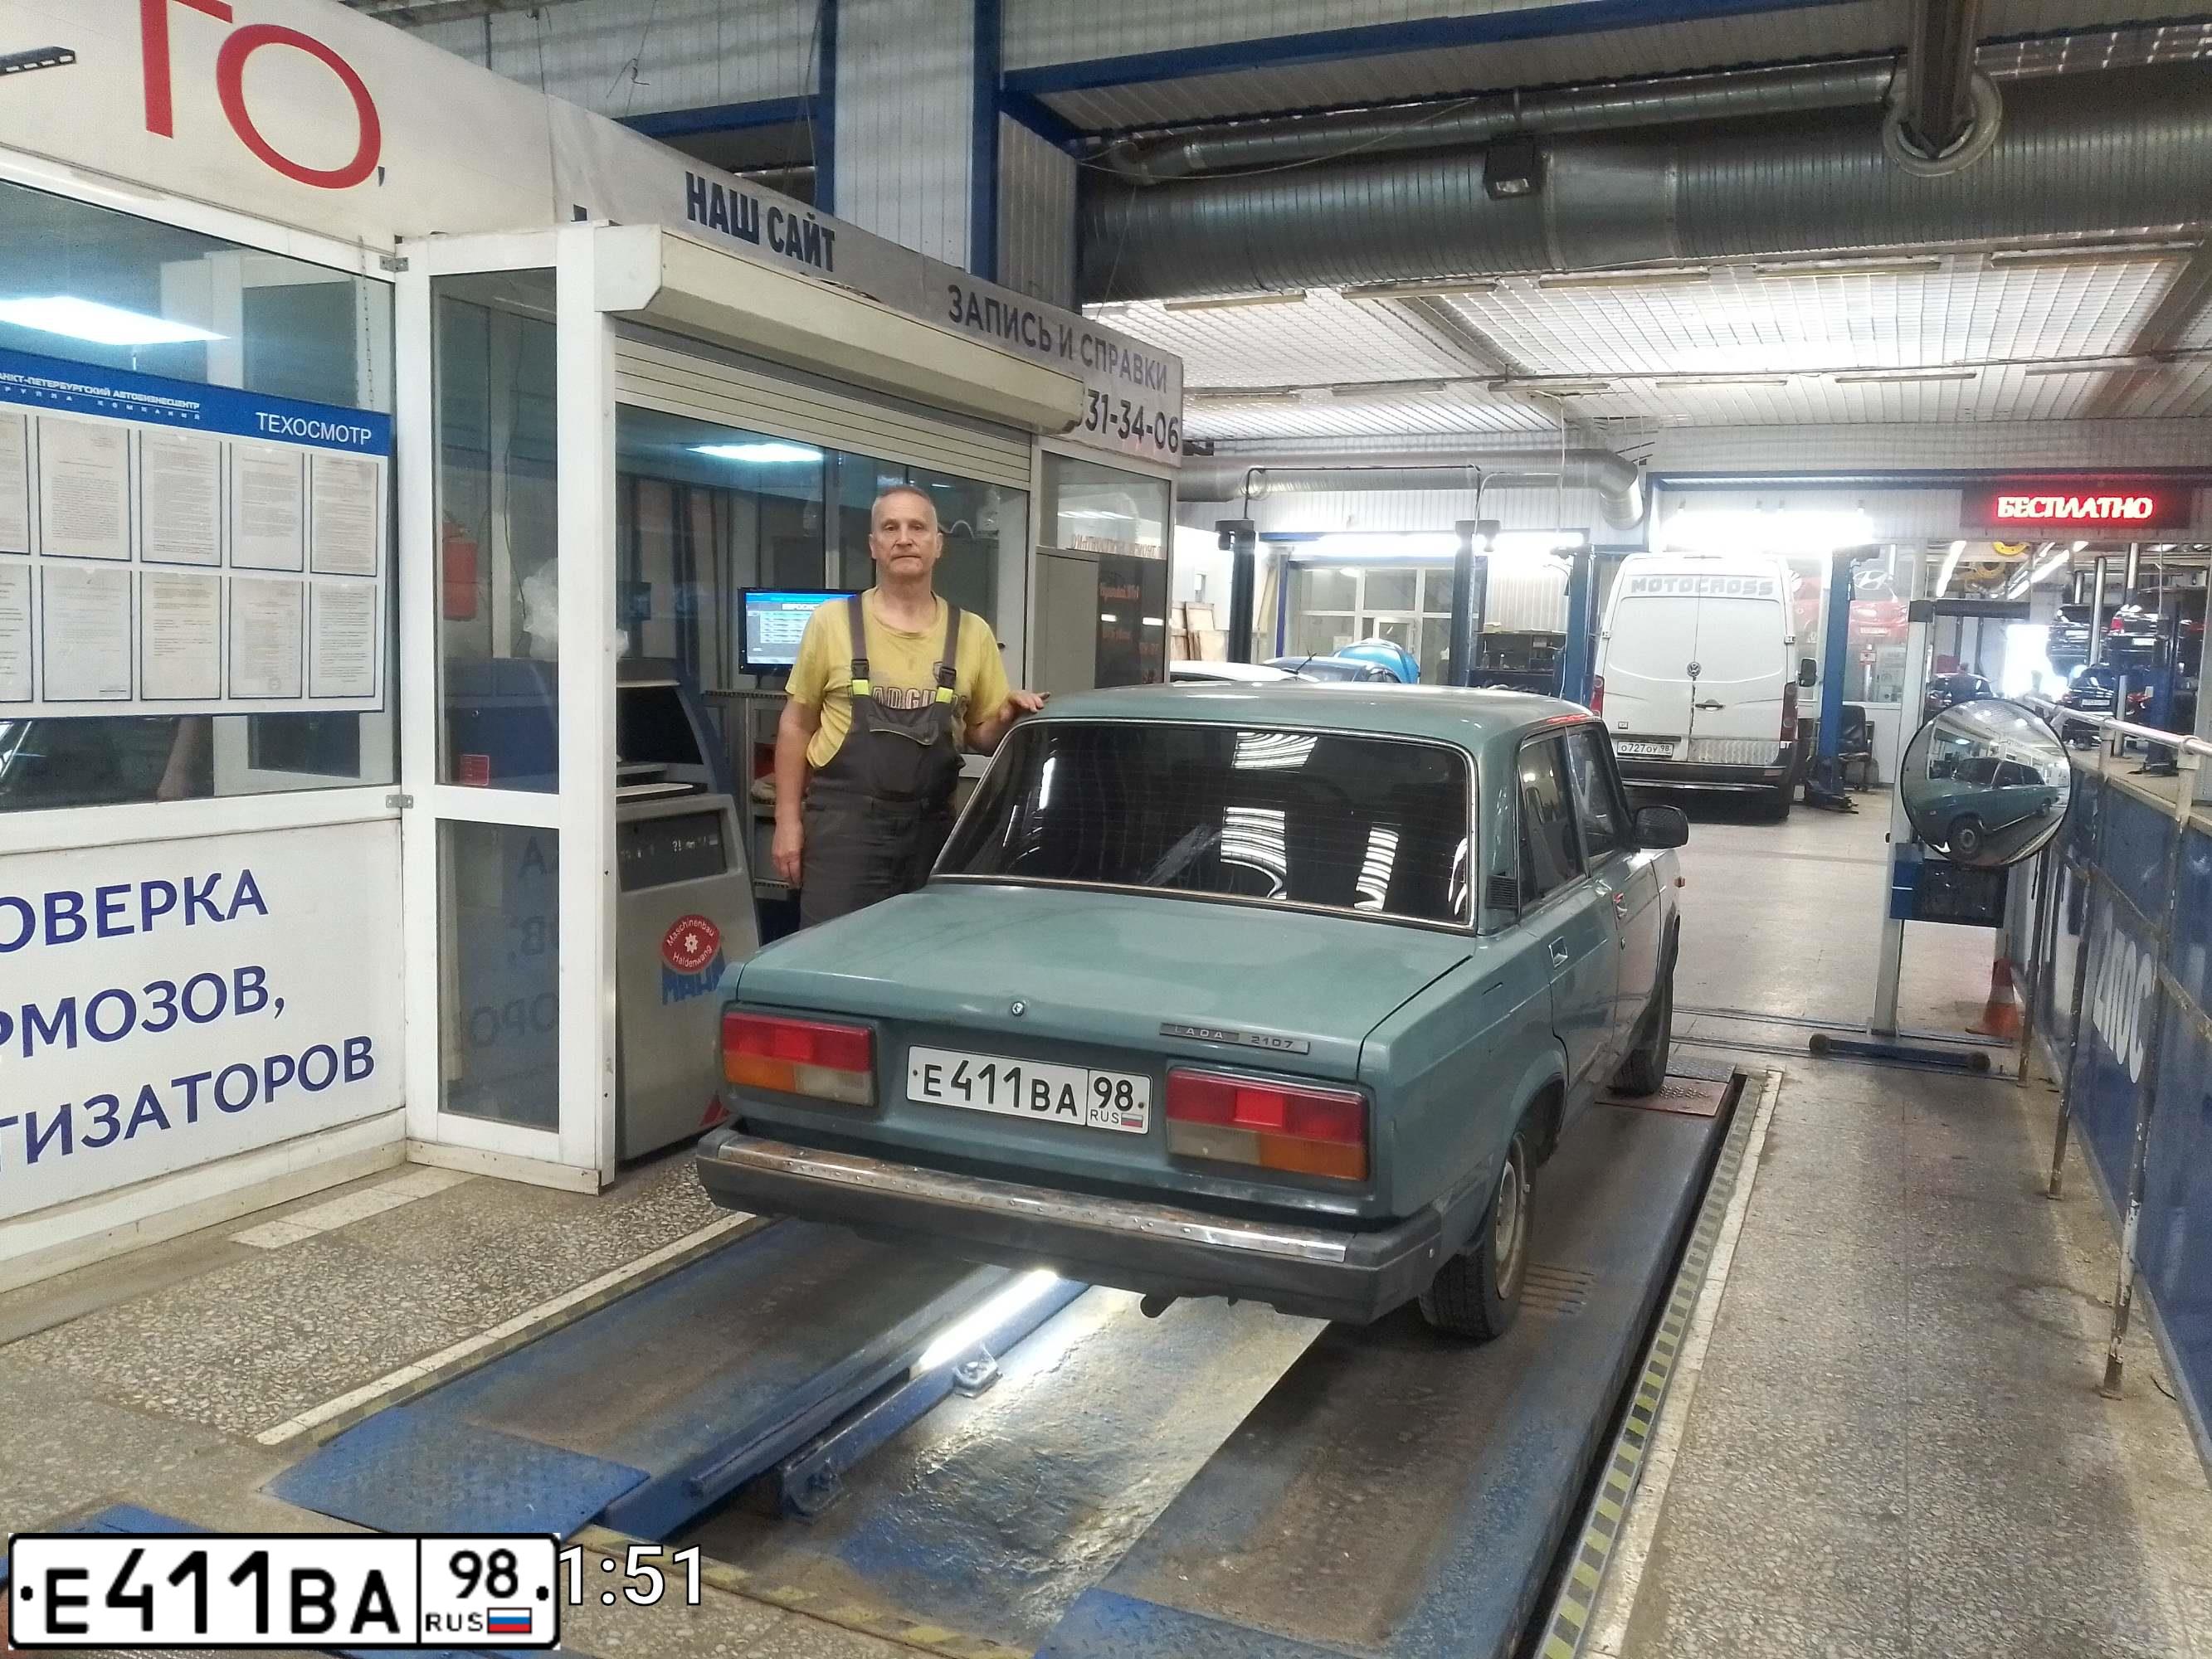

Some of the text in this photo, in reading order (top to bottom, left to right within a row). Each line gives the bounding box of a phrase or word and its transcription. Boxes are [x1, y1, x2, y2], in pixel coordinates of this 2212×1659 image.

[685, 171, 836, 272] НАШ САЙТ
[948, 285, 1167, 393] ЗАПИСЬ И СПРАВКИ
[256, 411, 373, 446] ТЕХОСМОТР
[1085, 389, 1178, 453] 31-34-06
[1997, 496, 2154, 519] БЕСПЛАТНО
[1631, 577, 1773, 596] MOTOCROSS
[666, 917, 714, 946] Maschinenbau
[1174, 1025, 1294, 1049] LADA 2107
[1094, 1077, 1133, 1112] 98
[1090, 1109, 1119, 1124] RUS
